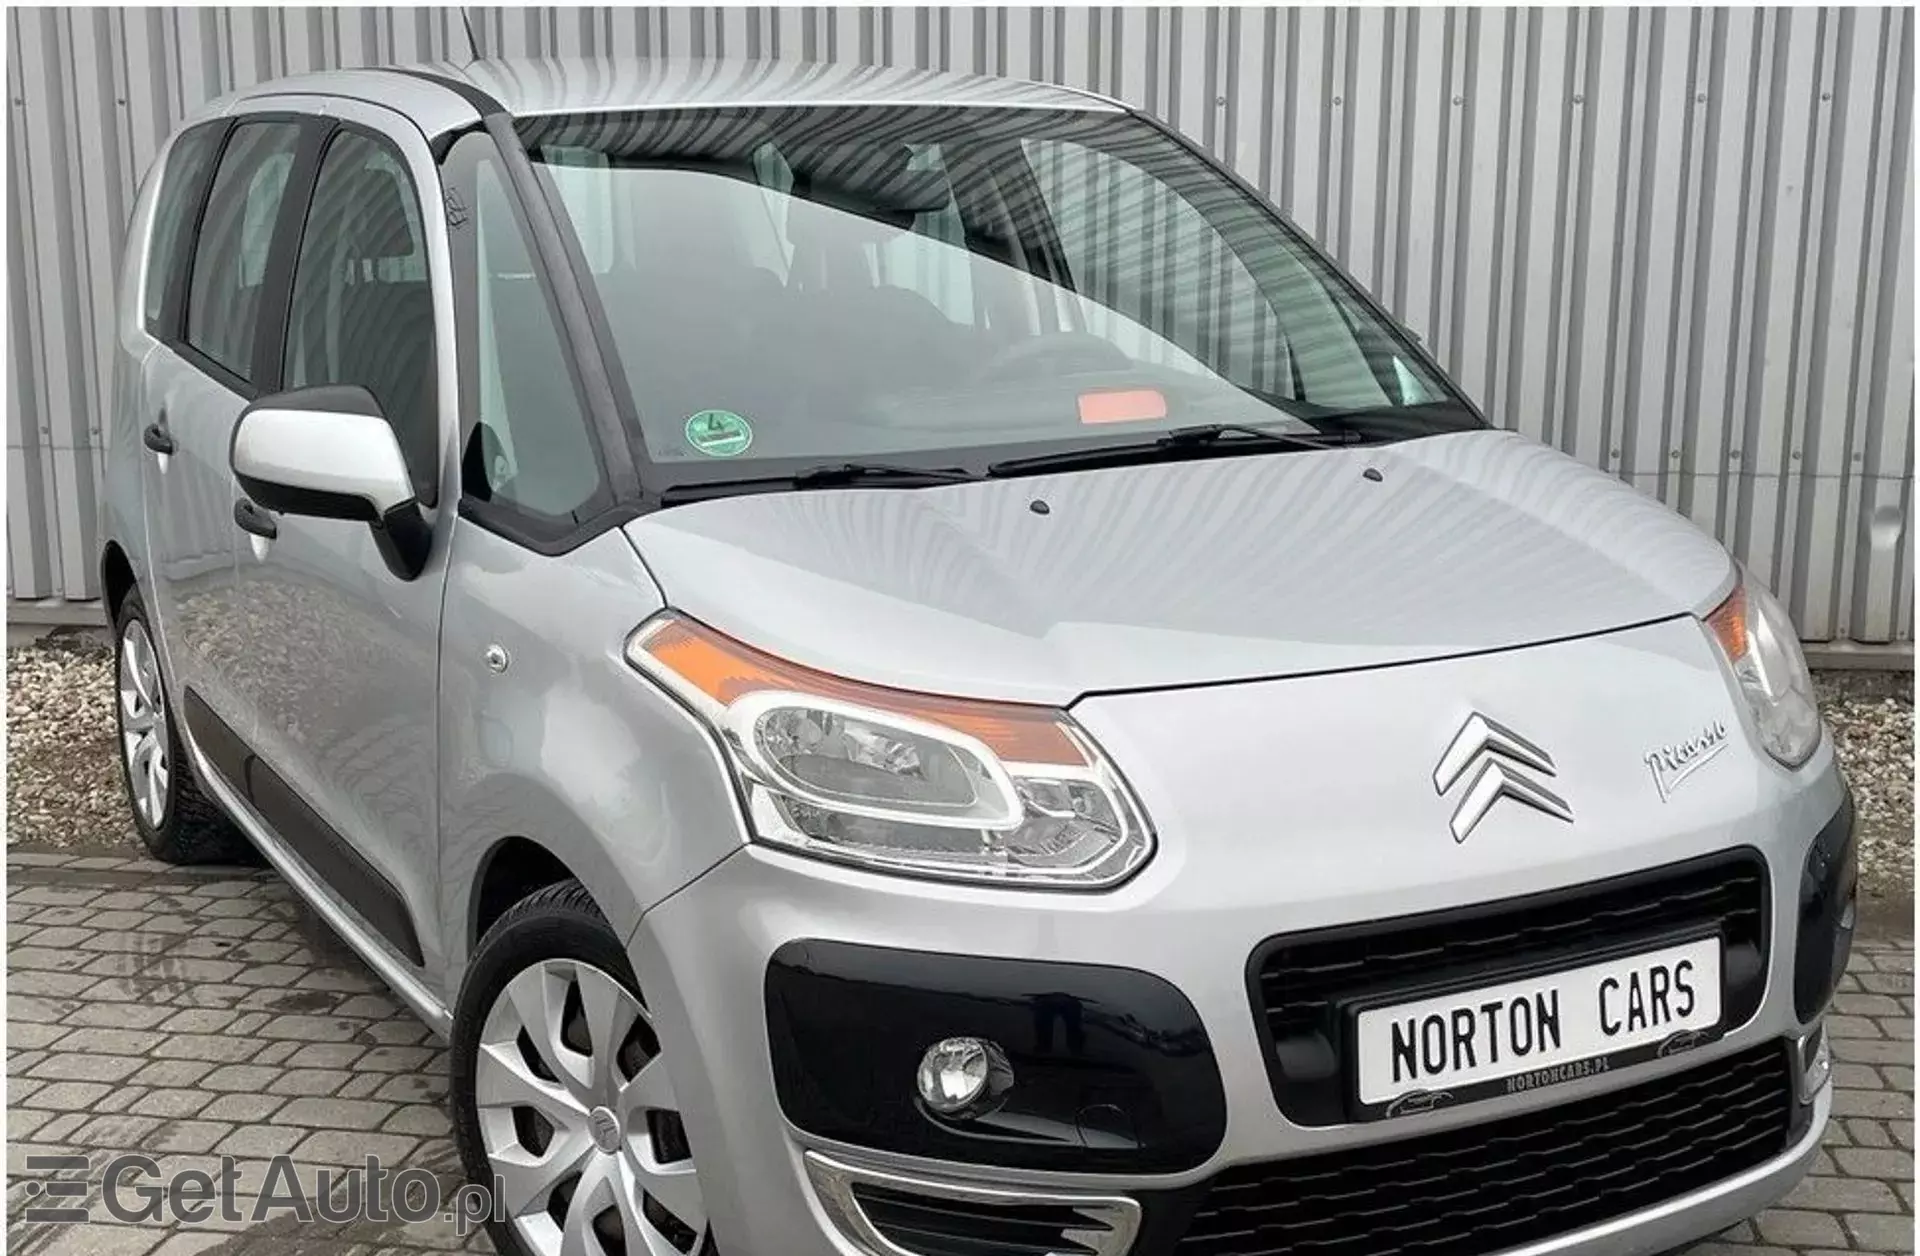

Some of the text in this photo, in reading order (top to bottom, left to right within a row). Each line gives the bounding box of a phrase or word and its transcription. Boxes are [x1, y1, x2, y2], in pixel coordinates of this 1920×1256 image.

[706, 412, 725, 431] 4
[1391, 959, 1695, 1082] NORTON CARS
[1507, 1056, 1610, 1092] NORTONCARS.PL
